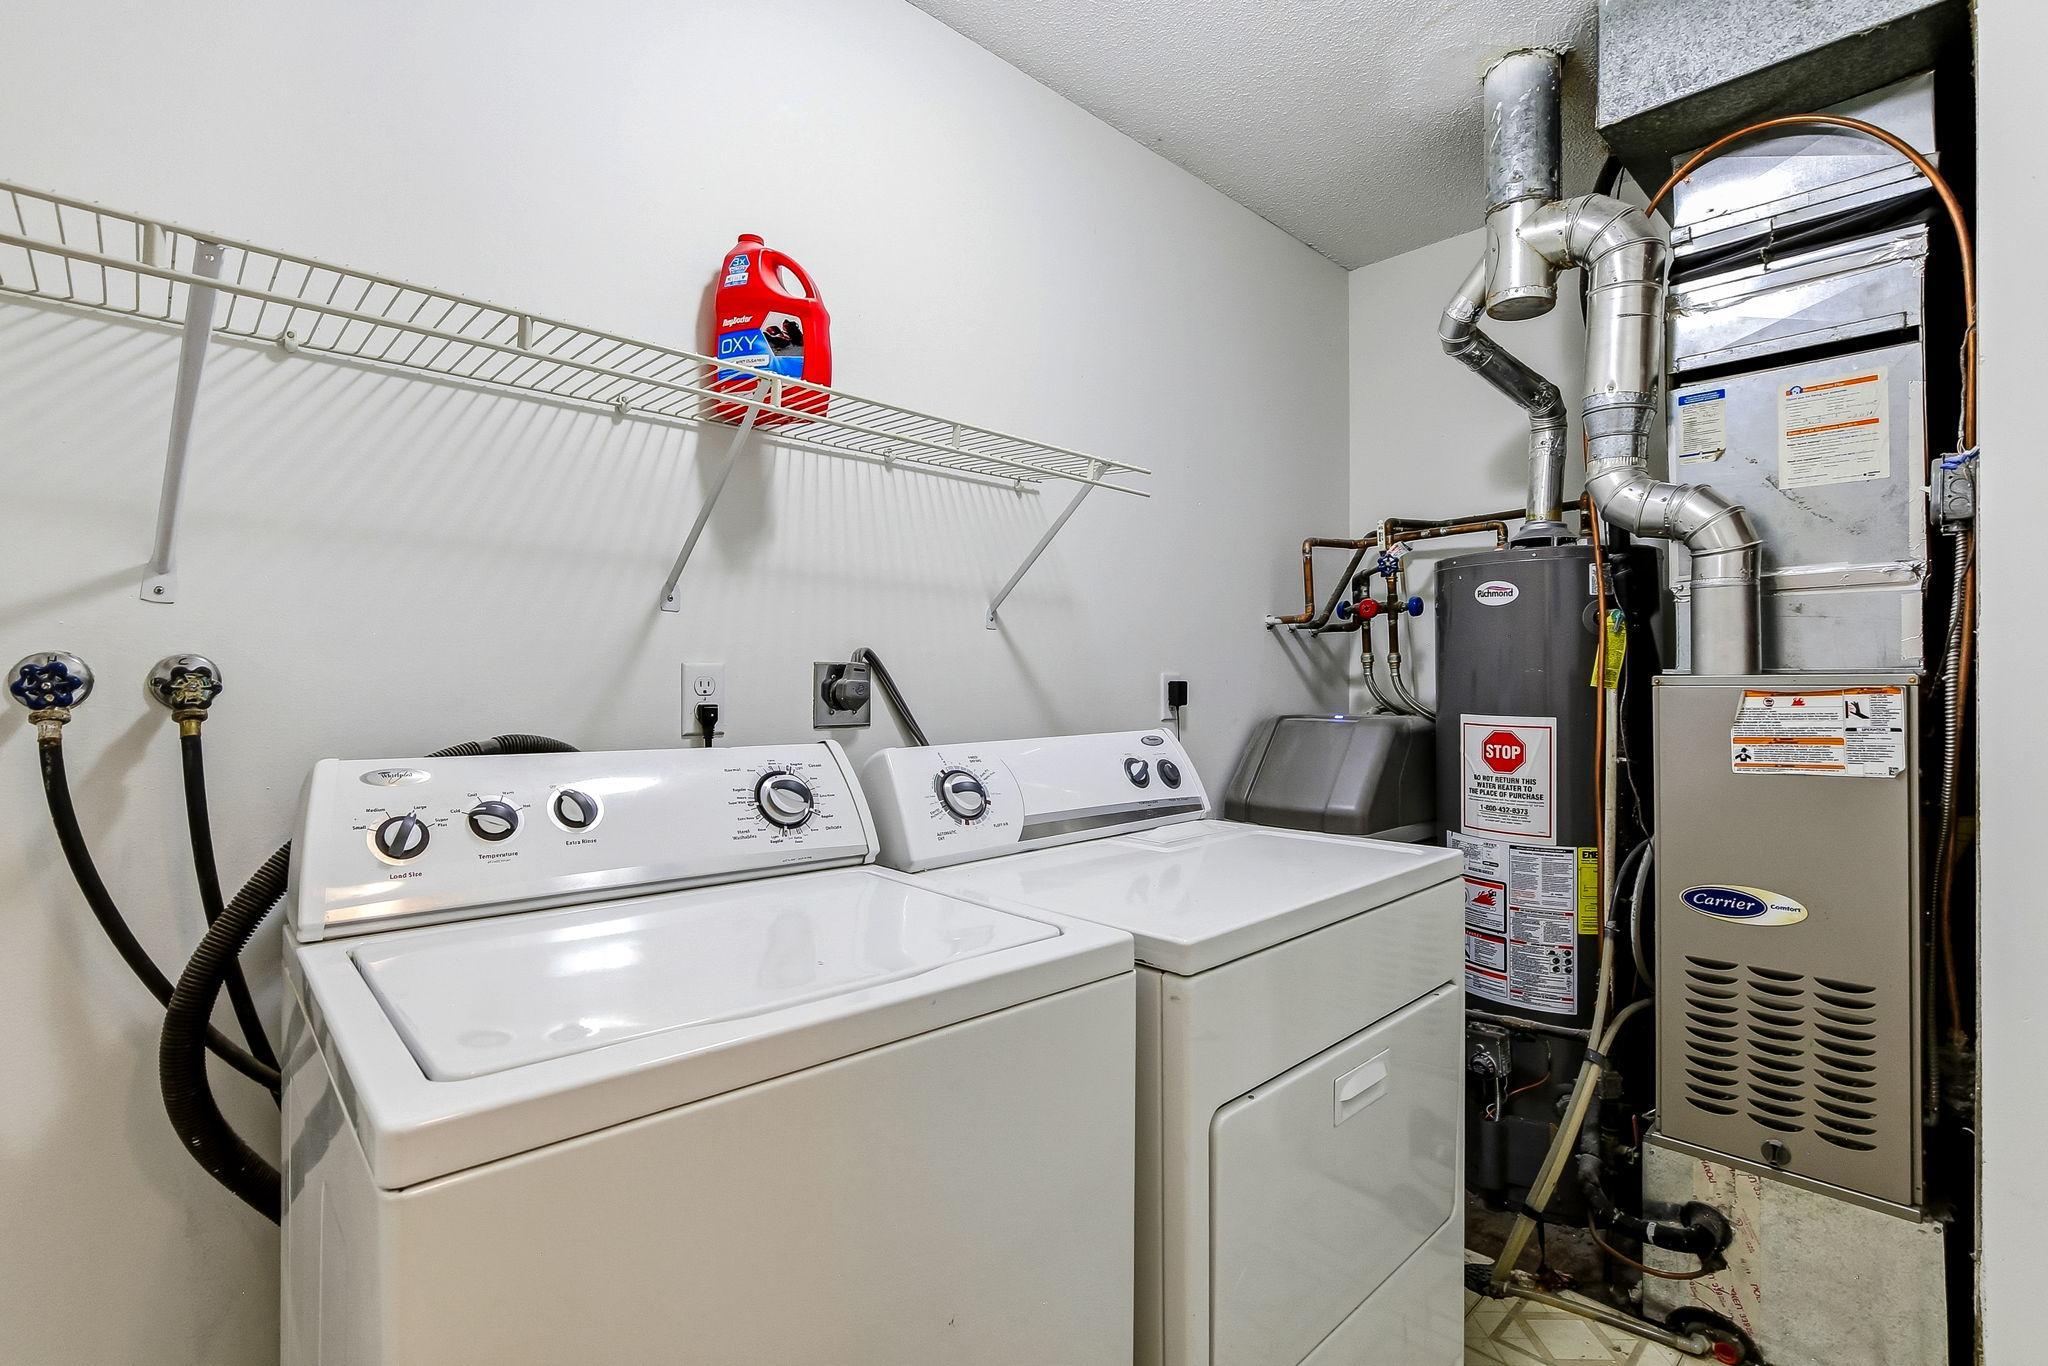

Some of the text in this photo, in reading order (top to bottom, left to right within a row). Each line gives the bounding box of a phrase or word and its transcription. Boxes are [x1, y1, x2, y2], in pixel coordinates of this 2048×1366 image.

[721, 335, 758, 354] OXY
[1477, 588, 1513, 598] Richmond
[1485, 744, 1521, 759] STOP
[1498, 784, 1521, 792] HEATER
[1480, 789, 1498, 797] PLACE
[1509, 792, 1544, 801] PURCHASE
[479, 851, 518, 860] Temperature
[1693, 893, 1755, 911] Carrier
